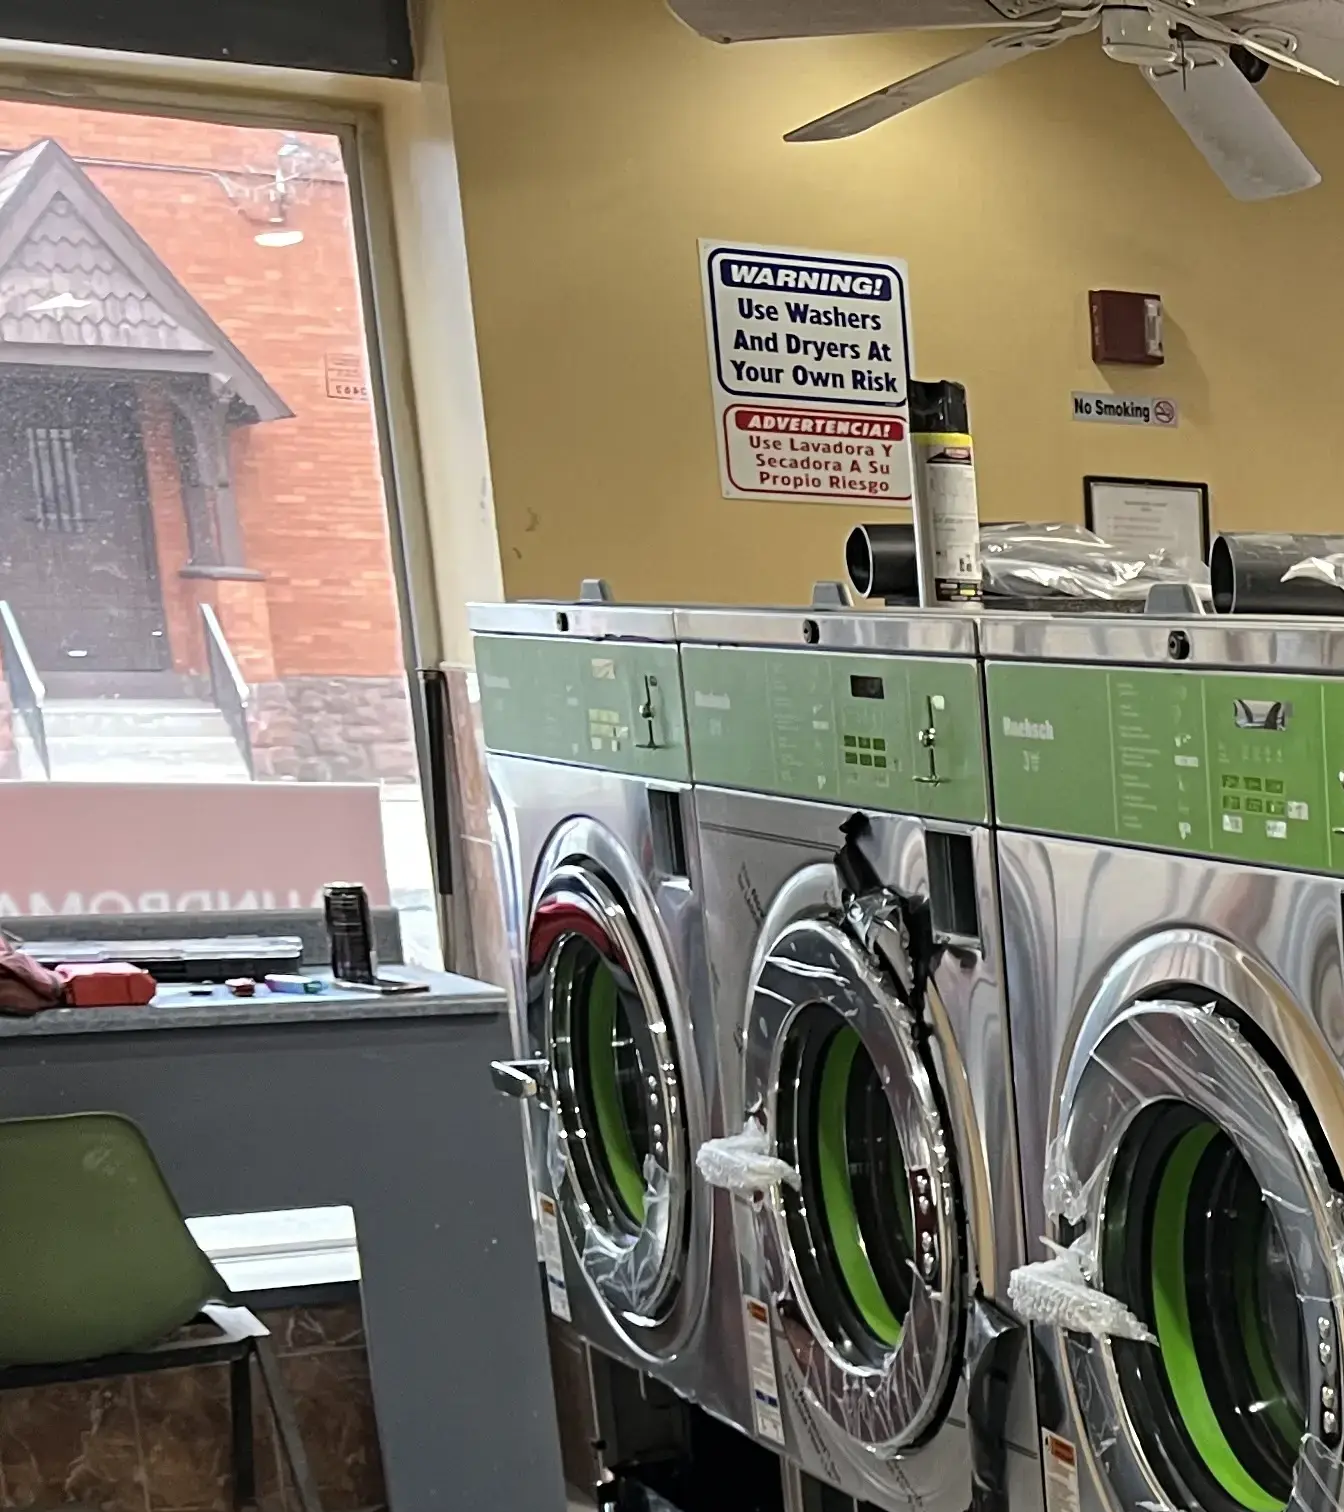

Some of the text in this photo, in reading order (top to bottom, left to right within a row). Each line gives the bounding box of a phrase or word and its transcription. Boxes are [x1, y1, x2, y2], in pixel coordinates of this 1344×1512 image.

[731, 264, 883, 296] WARNING!
[738, 298, 881, 330] Use Washers
[733, 329, 892, 362] And Dryers At
[730, 360, 898, 393] Your Own Risk
[1074, 398, 1150, 423] No Smoking
[748, 414, 891, 438] ADVERTENCIA!
[750, 435, 893, 457] Use Lavadora Y
[756, 453, 890, 475] Secadora A Su
[760, 471, 889, 494] Propio Riesgo
